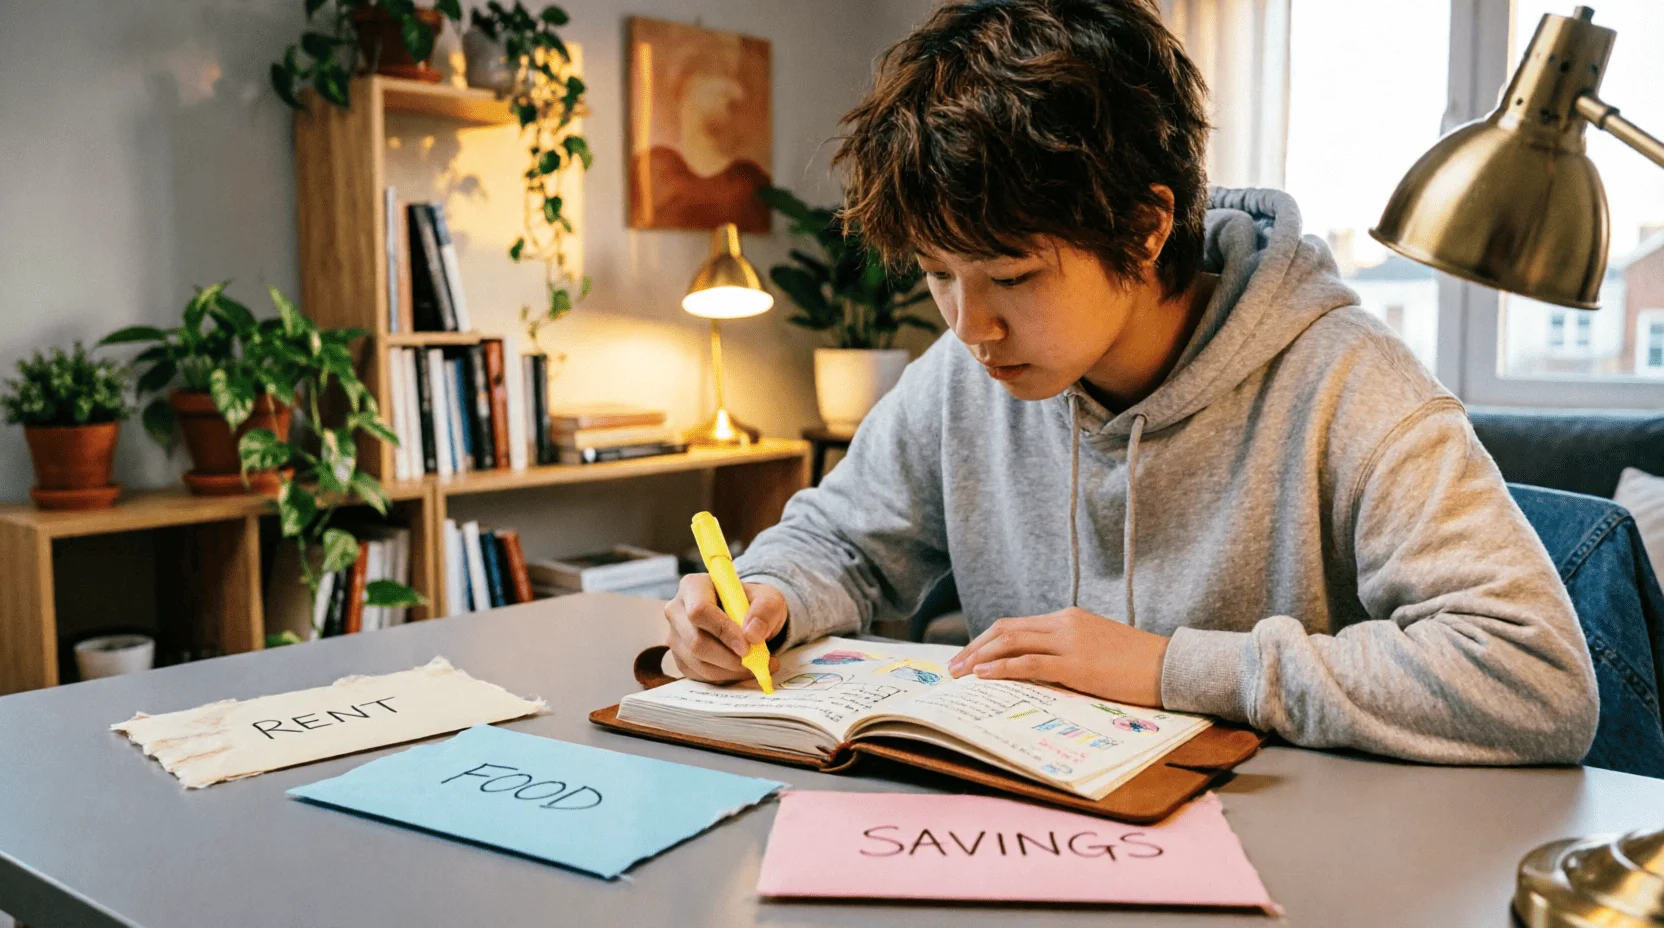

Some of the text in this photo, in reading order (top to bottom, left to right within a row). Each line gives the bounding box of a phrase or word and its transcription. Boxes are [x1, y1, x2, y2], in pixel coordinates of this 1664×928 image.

[251, 696, 398, 740] RENT
[440, 762, 603, 810] FOOD
[859, 825, 1165, 862] SAVINGS
